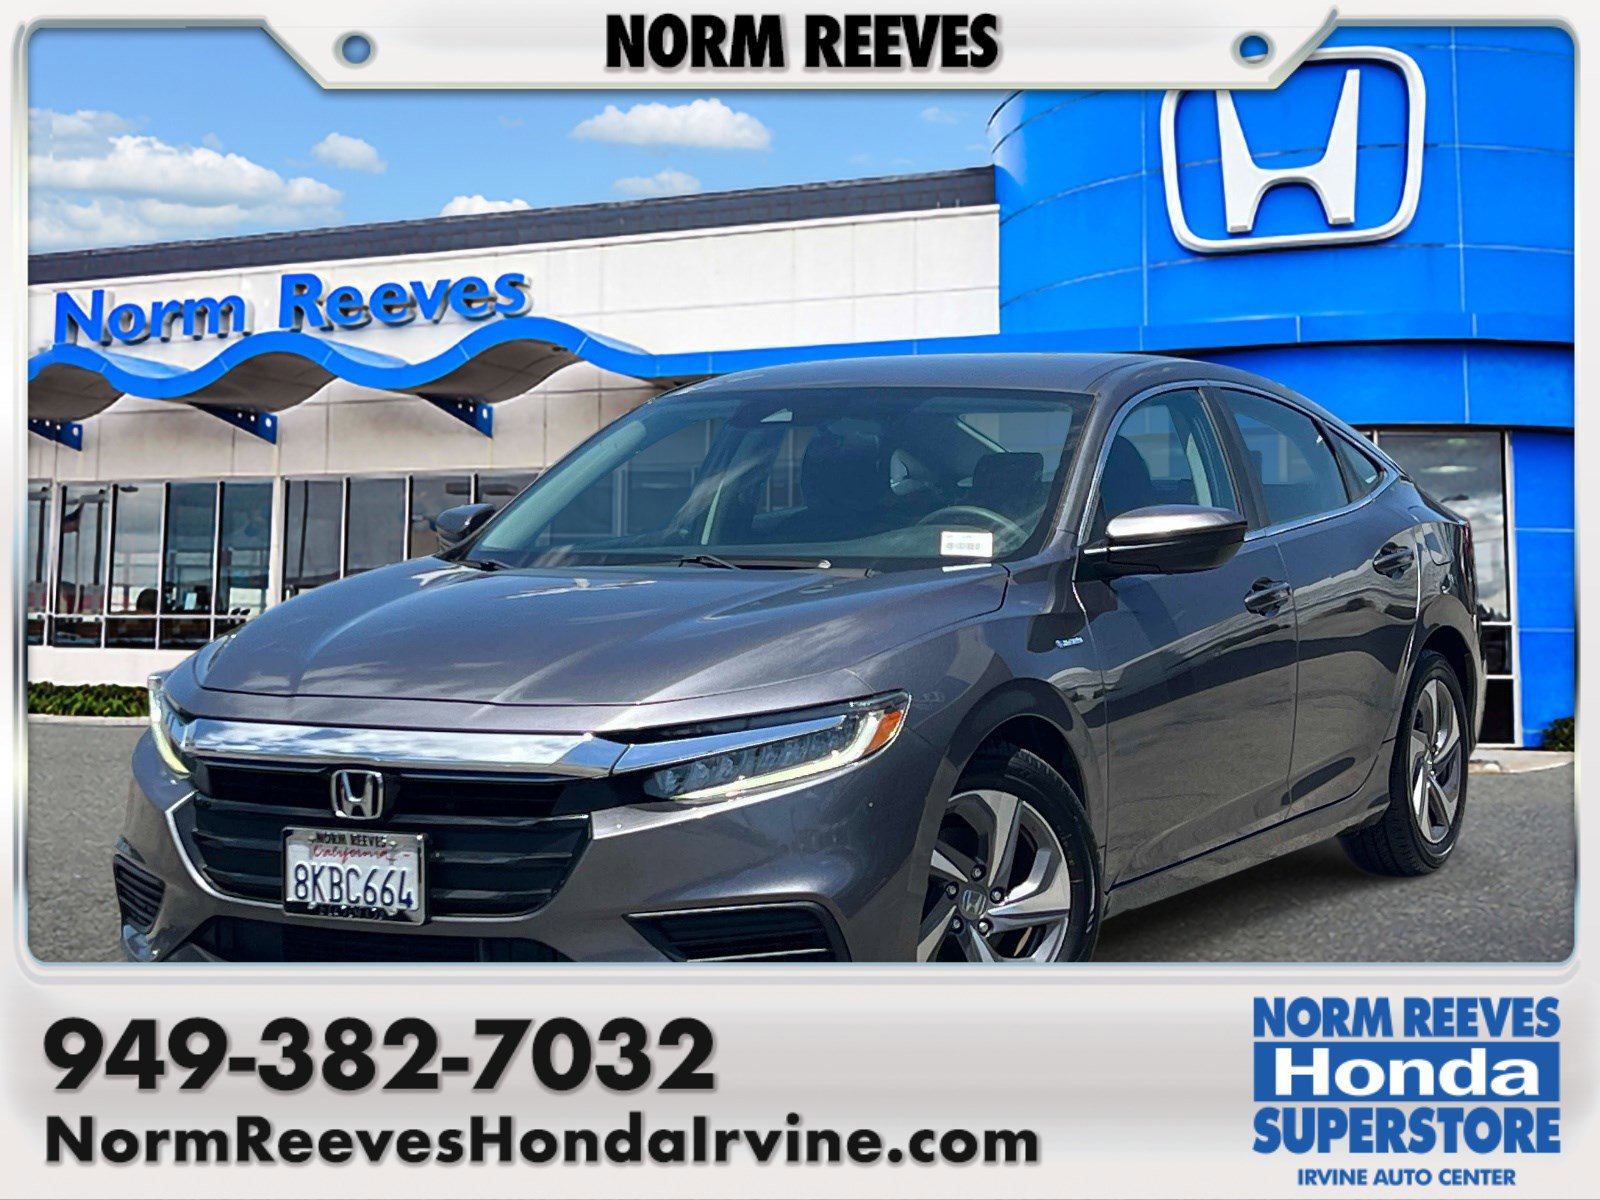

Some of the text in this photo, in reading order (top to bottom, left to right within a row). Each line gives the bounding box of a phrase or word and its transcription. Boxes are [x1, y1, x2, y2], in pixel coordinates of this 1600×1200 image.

[54, 271, 529, 346] Norm Reeves
[313, 845, 389, 864] California
[294, 863, 414, 908] 8KBC664
